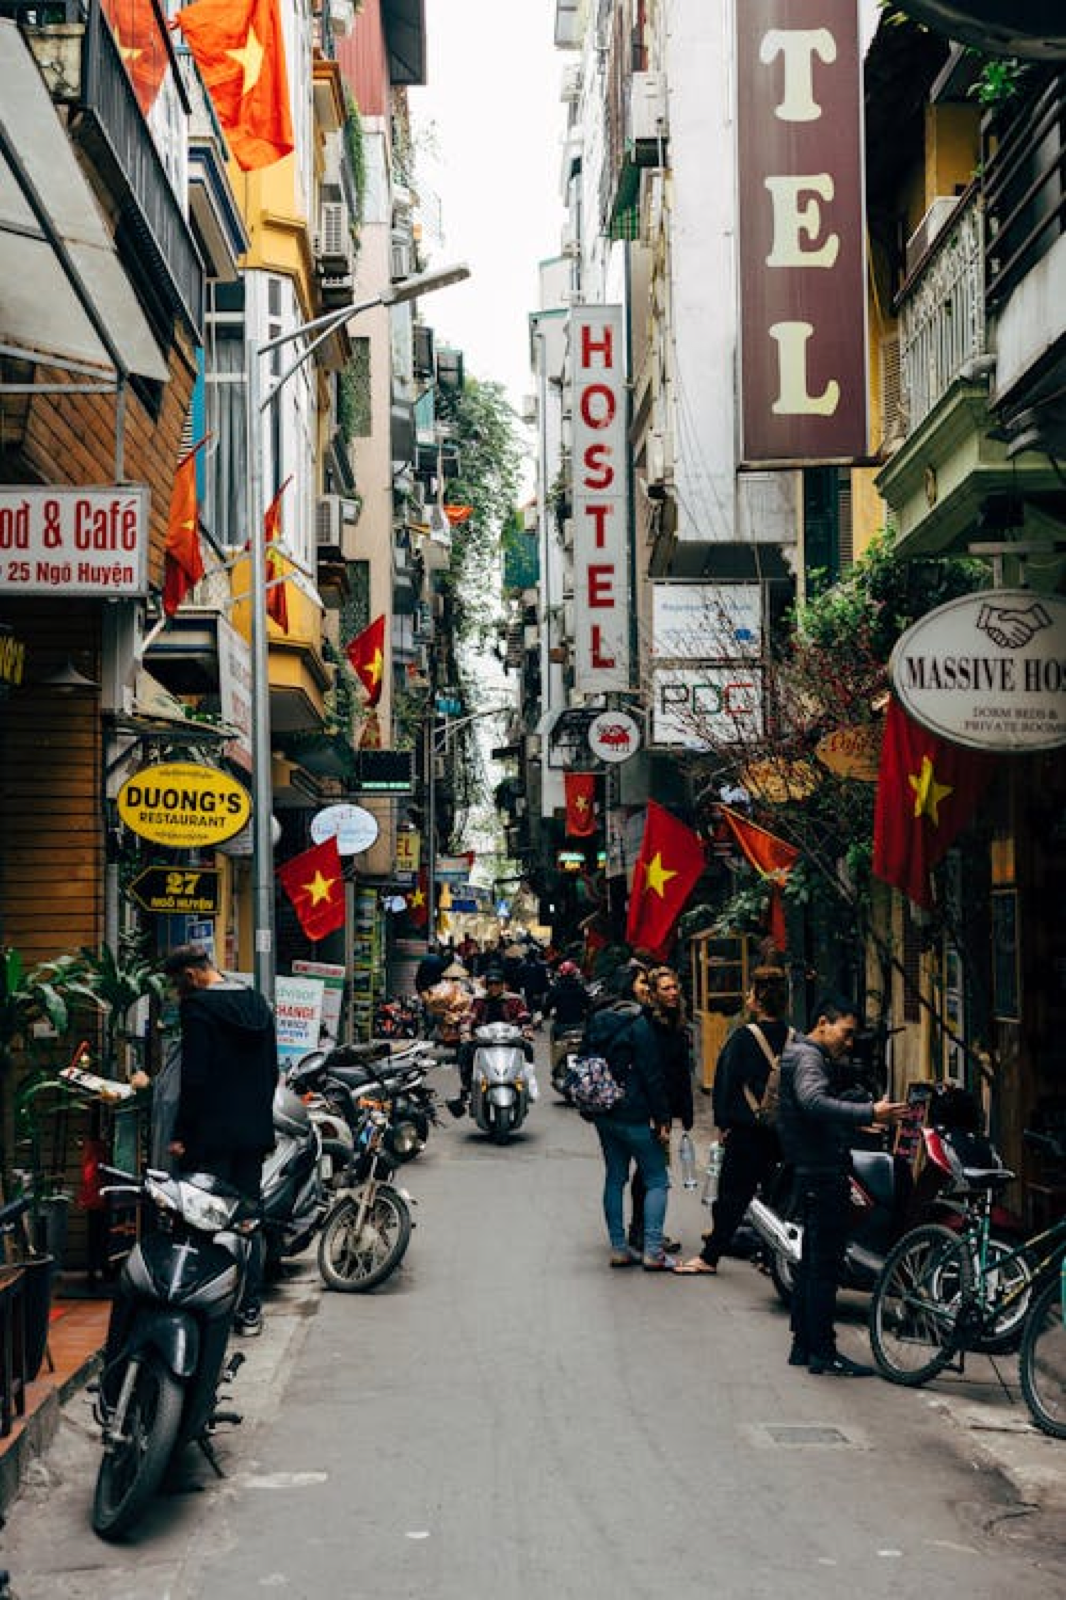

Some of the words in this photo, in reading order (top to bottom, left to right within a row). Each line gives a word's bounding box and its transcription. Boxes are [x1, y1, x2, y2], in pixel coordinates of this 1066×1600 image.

[580, 325, 616, 668] HOSTEL
[44, 500, 62, 549] &
[75, 499, 137, 551] Café
[8, 562, 30, 581] 25
[78, 561, 133, 587] Huyện
[906, 656, 1015, 691] MASSIVE
[661, 682, 753, 717] PDC
[964, 720, 1016, 732] PRIVATE
[973, 707, 1011, 718] DORM
[1015, 708, 1046, 720] BEDS
[127, 786, 242, 814] DUONG'S
[139, 812, 226, 828] RESTAURANT
[165, 872, 201, 895] 27
